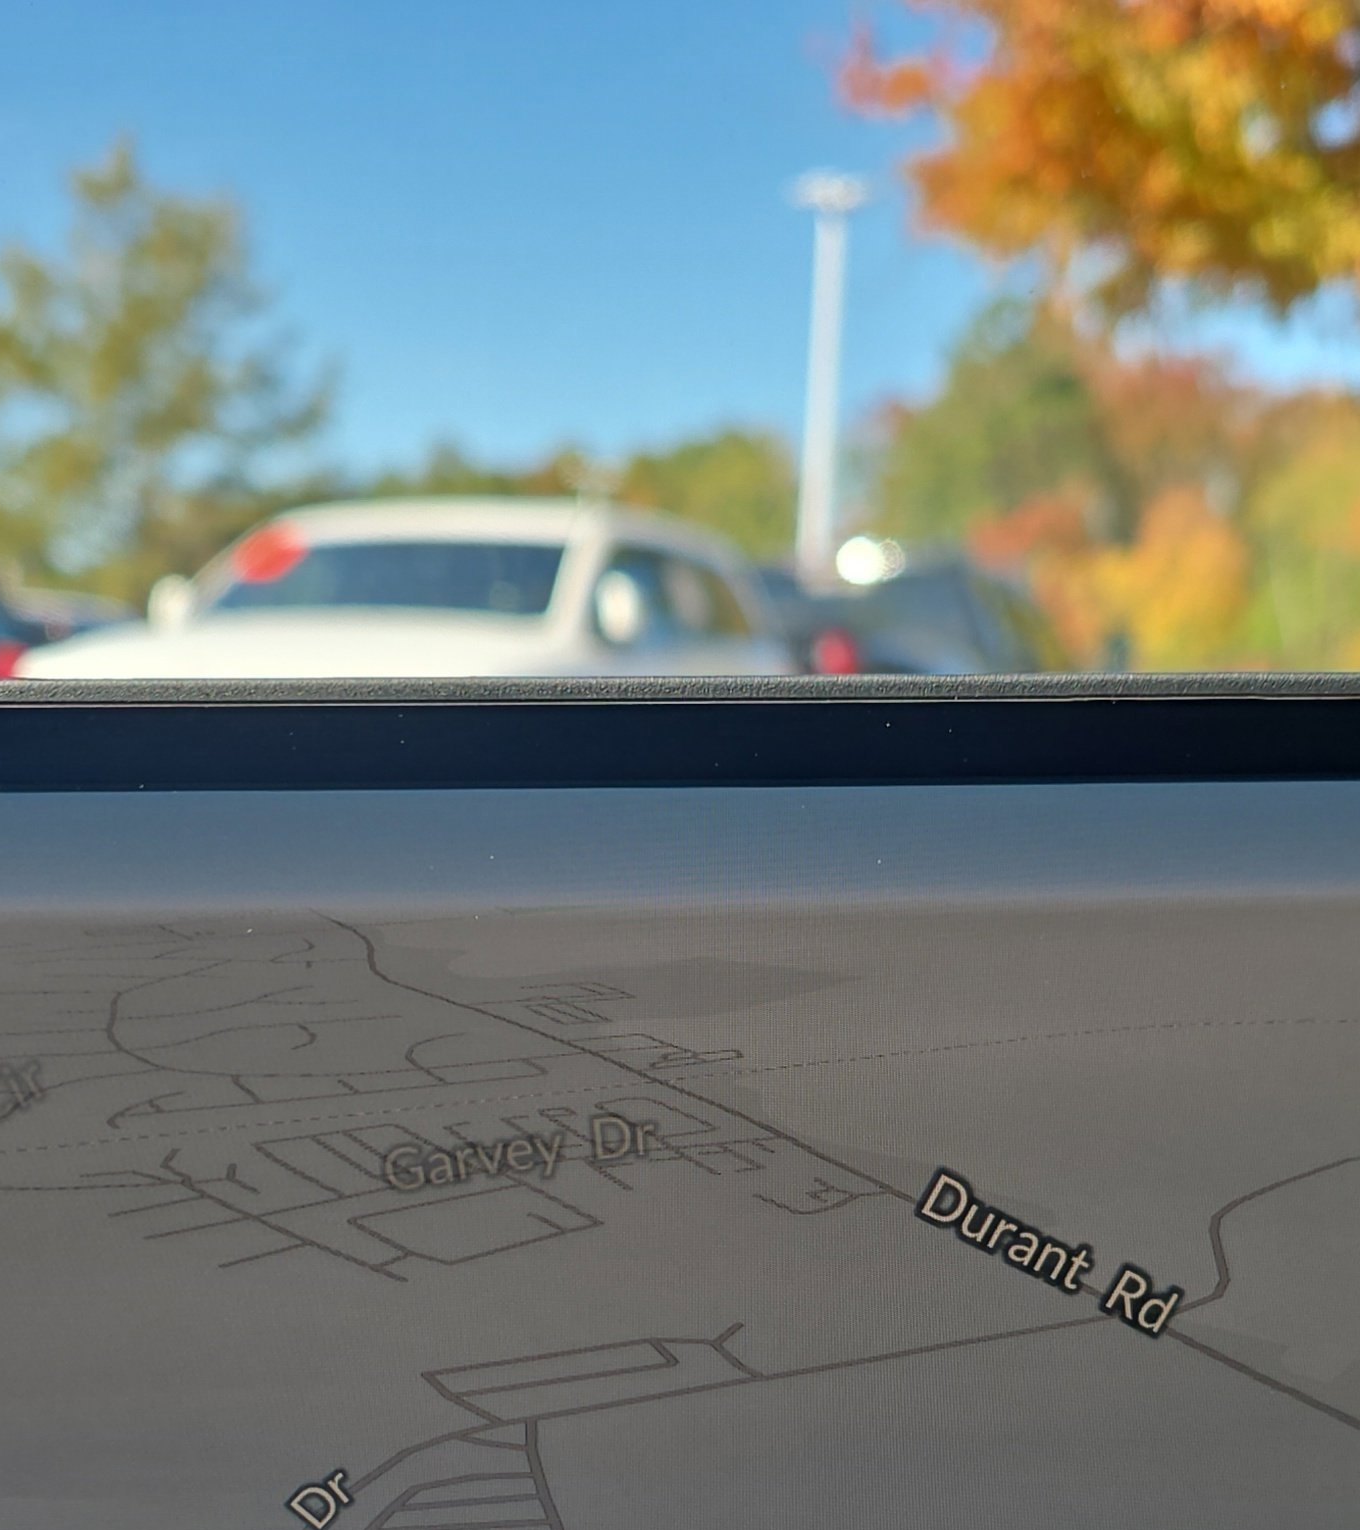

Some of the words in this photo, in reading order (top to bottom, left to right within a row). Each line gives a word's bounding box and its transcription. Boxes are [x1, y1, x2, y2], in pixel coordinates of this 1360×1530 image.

[384, 1131, 563, 1191] Garvey
[592, 1115, 657, 1160] Dr
[921, 1173, 1090, 1290] Durant
[1105, 1270, 1178, 1333] Rd
[290, 1472, 350, 1530] Dr
